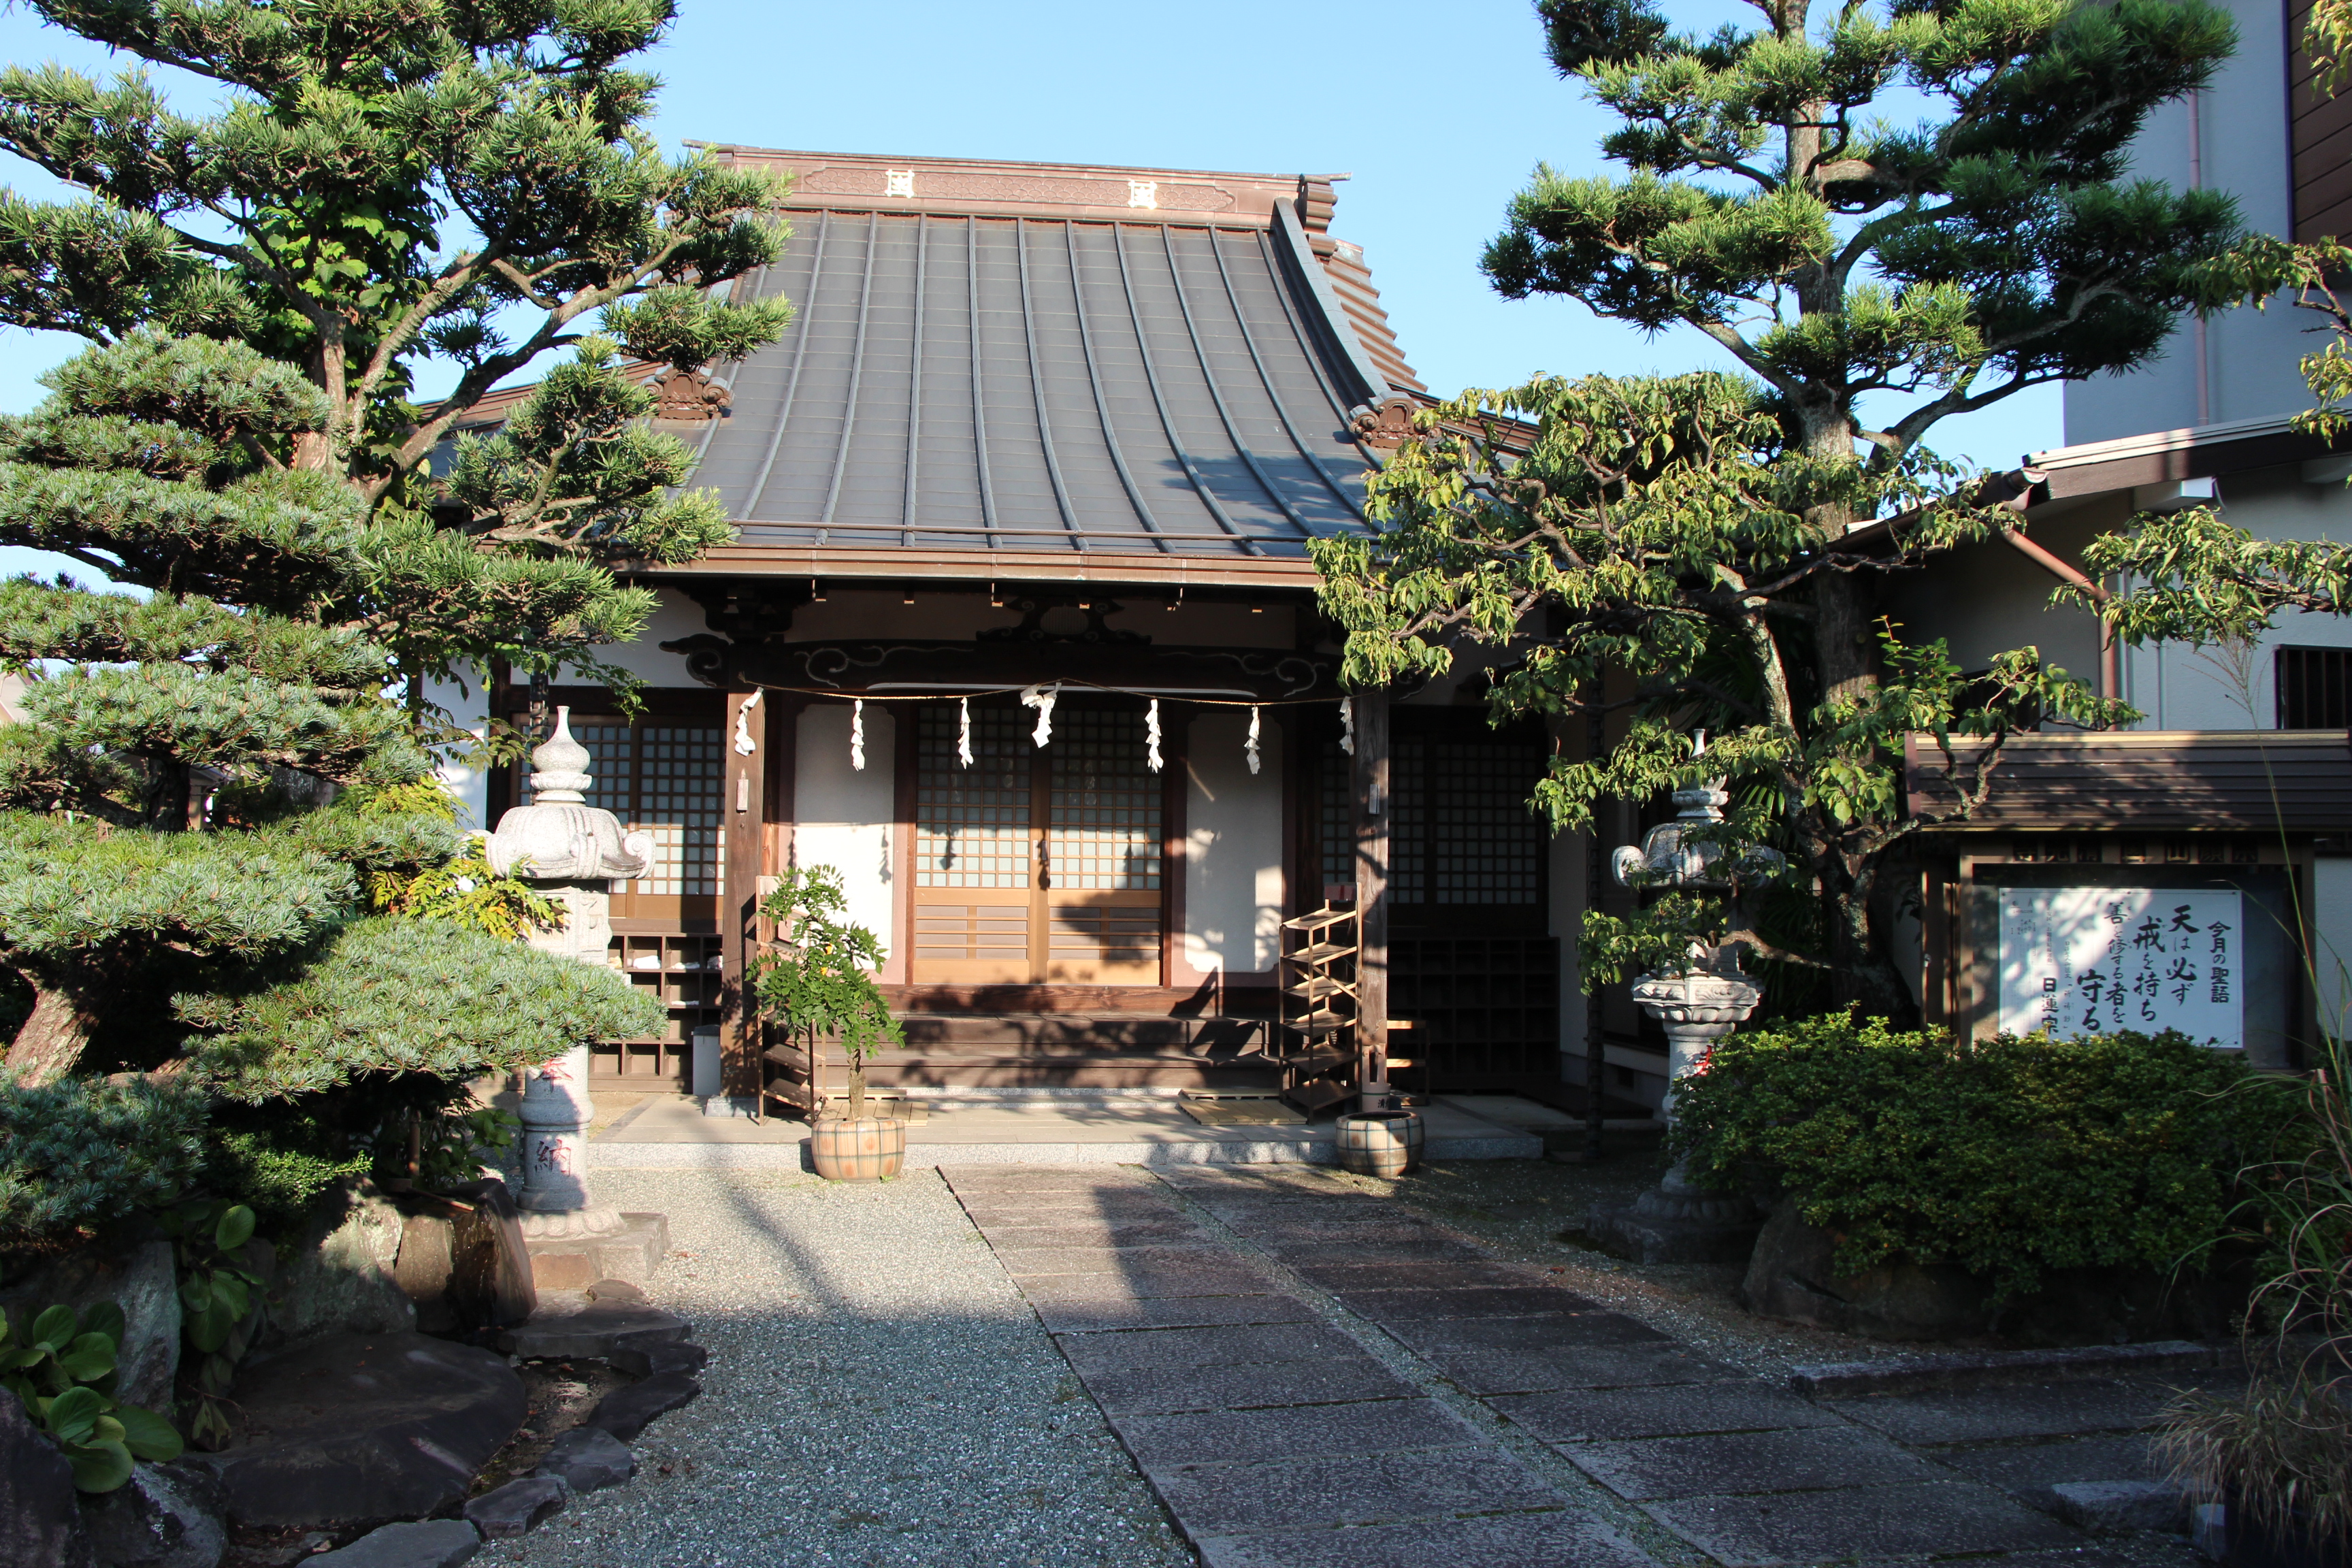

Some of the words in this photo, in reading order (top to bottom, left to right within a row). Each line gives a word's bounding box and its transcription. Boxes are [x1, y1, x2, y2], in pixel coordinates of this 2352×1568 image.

[2078, 969, 2106, 1031] 守る
[2104, 902, 2129, 1024] 善を修する者を
[2134, 915, 2166, 1022] 戒を持ち
[2166, 904, 2200, 1007] 天は必ず
[2208, 920, 2232, 1003] 今月の聖語
[2042, 977, 2059, 1034] 日蓮宗
